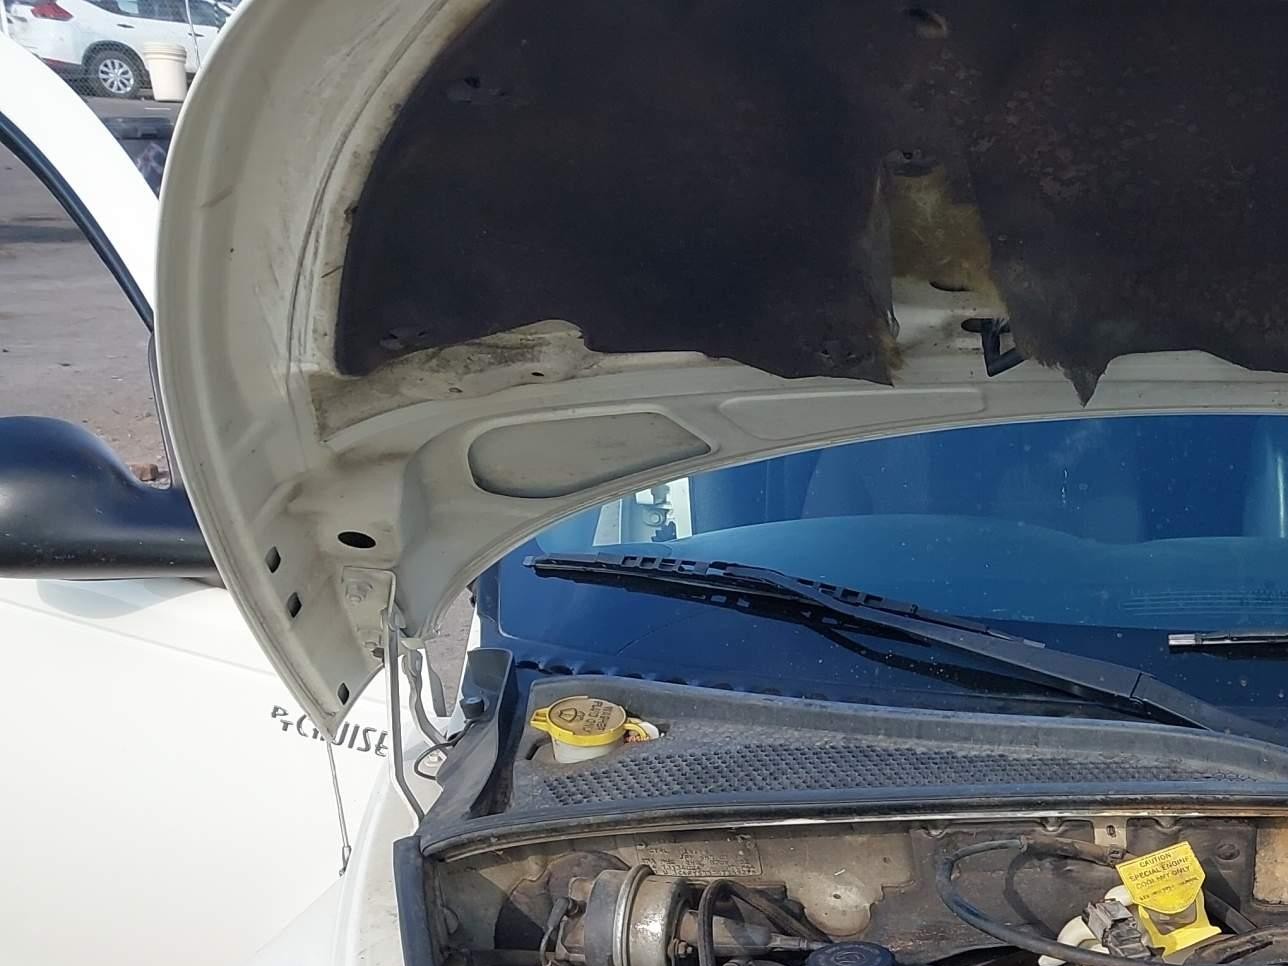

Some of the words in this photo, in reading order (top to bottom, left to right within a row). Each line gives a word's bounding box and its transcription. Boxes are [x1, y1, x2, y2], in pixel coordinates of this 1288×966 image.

[1139, 852, 1172, 868] CAUTION
[1129, 867, 1161, 882] SPECIAL
[1171, 865, 1192, 877] ONLY
